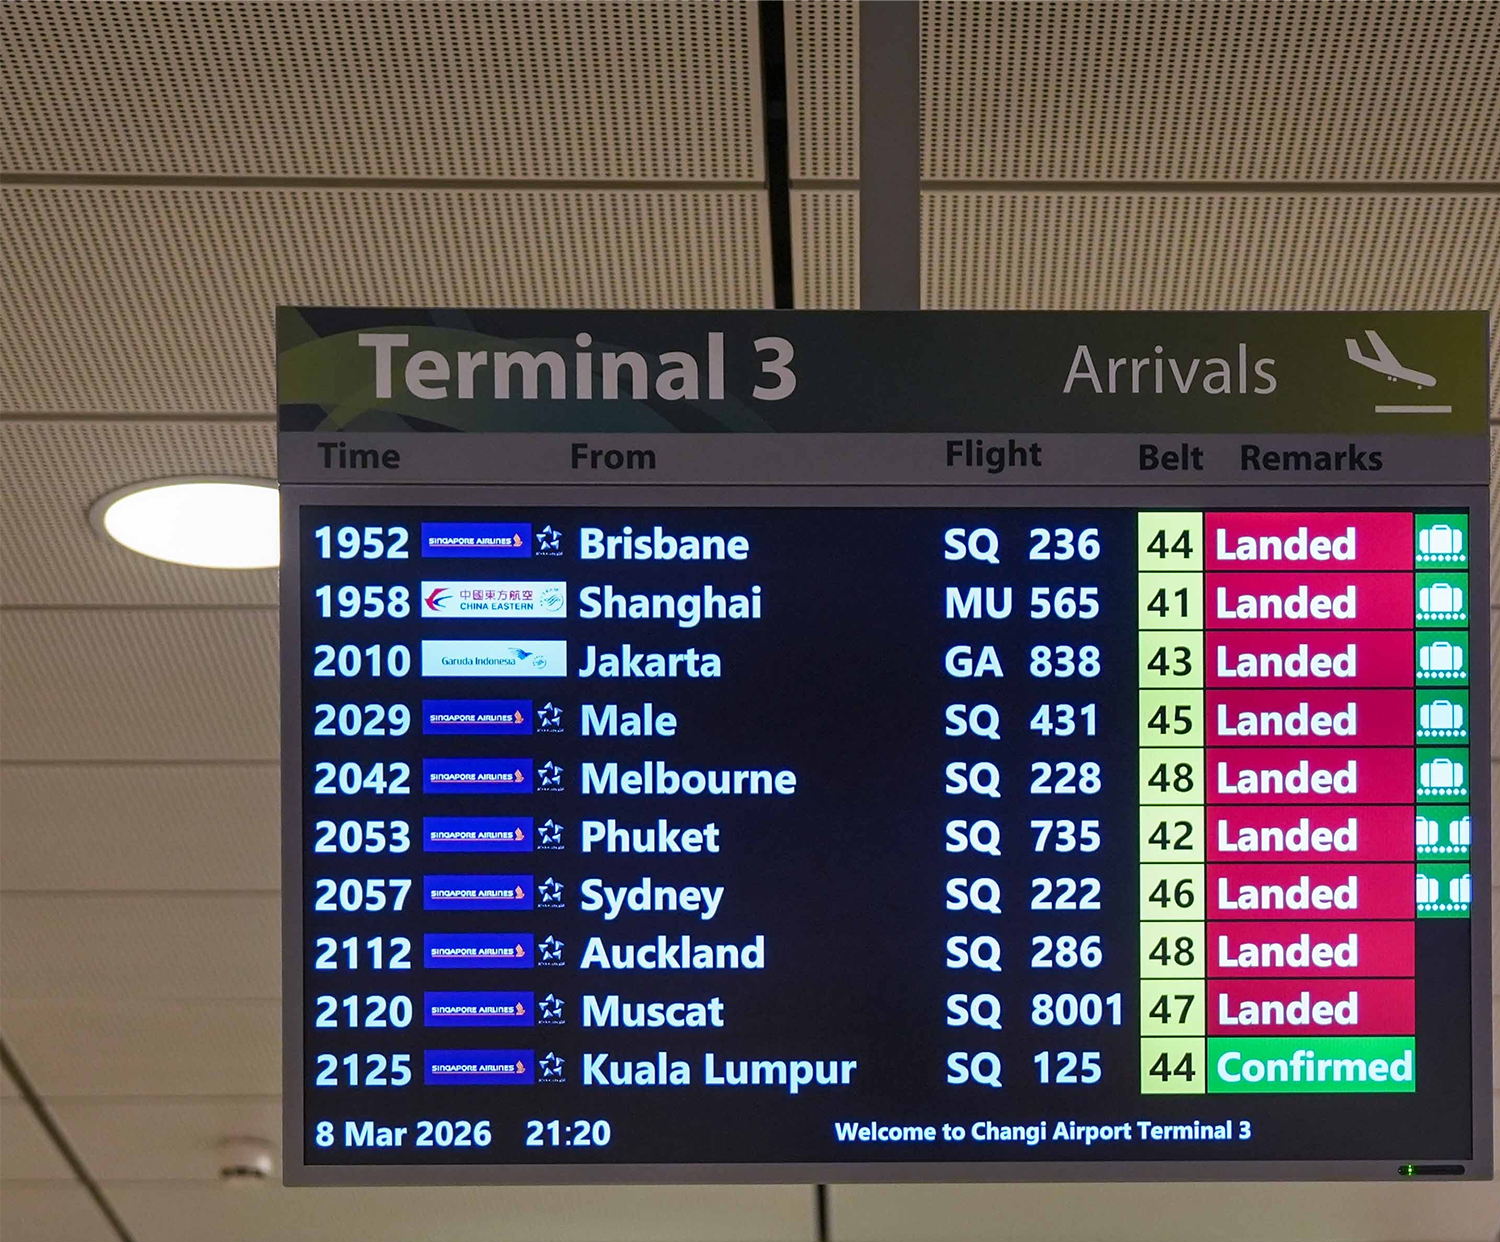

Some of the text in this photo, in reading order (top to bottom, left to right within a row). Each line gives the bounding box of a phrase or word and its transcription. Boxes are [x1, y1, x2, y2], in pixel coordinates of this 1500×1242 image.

[358, 331, 797, 401] Terminal 3
[1062, 342, 1277, 395] Arrivals
[317, 440, 401, 470] Time
[571, 442, 656, 470] From
[946, 438, 1042, 475] Flight
[1139, 442, 1204, 471] Belt
[1240, 443, 1383, 472] Remarks
[315, 525, 1356, 564] 1952 Brisbane SQ 236 44 Landed
[315, 584, 1357, 628] 1958 Shanghai MU 565 41 Landed
[460, 590, 533, 601] 中國東方航空
[313, 643, 1357, 678] 2010 Jakarta GA 838 43 Landed
[442, 657, 516, 665] Garuda Indonesia
[314, 759, 1357, 798] 2042 Melbourne SQ 228 48 Landed
[315, 875, 1358, 920] 2057 Sydney SQ 222 46 Landed
[315, 991, 1358, 1030] 2120 Muscat SQ 8001 47 Landed
[316, 1049, 1413, 1094] 2125 Kuala Lumpur SQ 125 44 Confirmed
[316, 1120, 492, 1147] 8 Mar 2026
[526, 1119, 611, 1146] 21:20
[834, 1119, 1252, 1146] Welcome to Changi Airport Terminal 3
